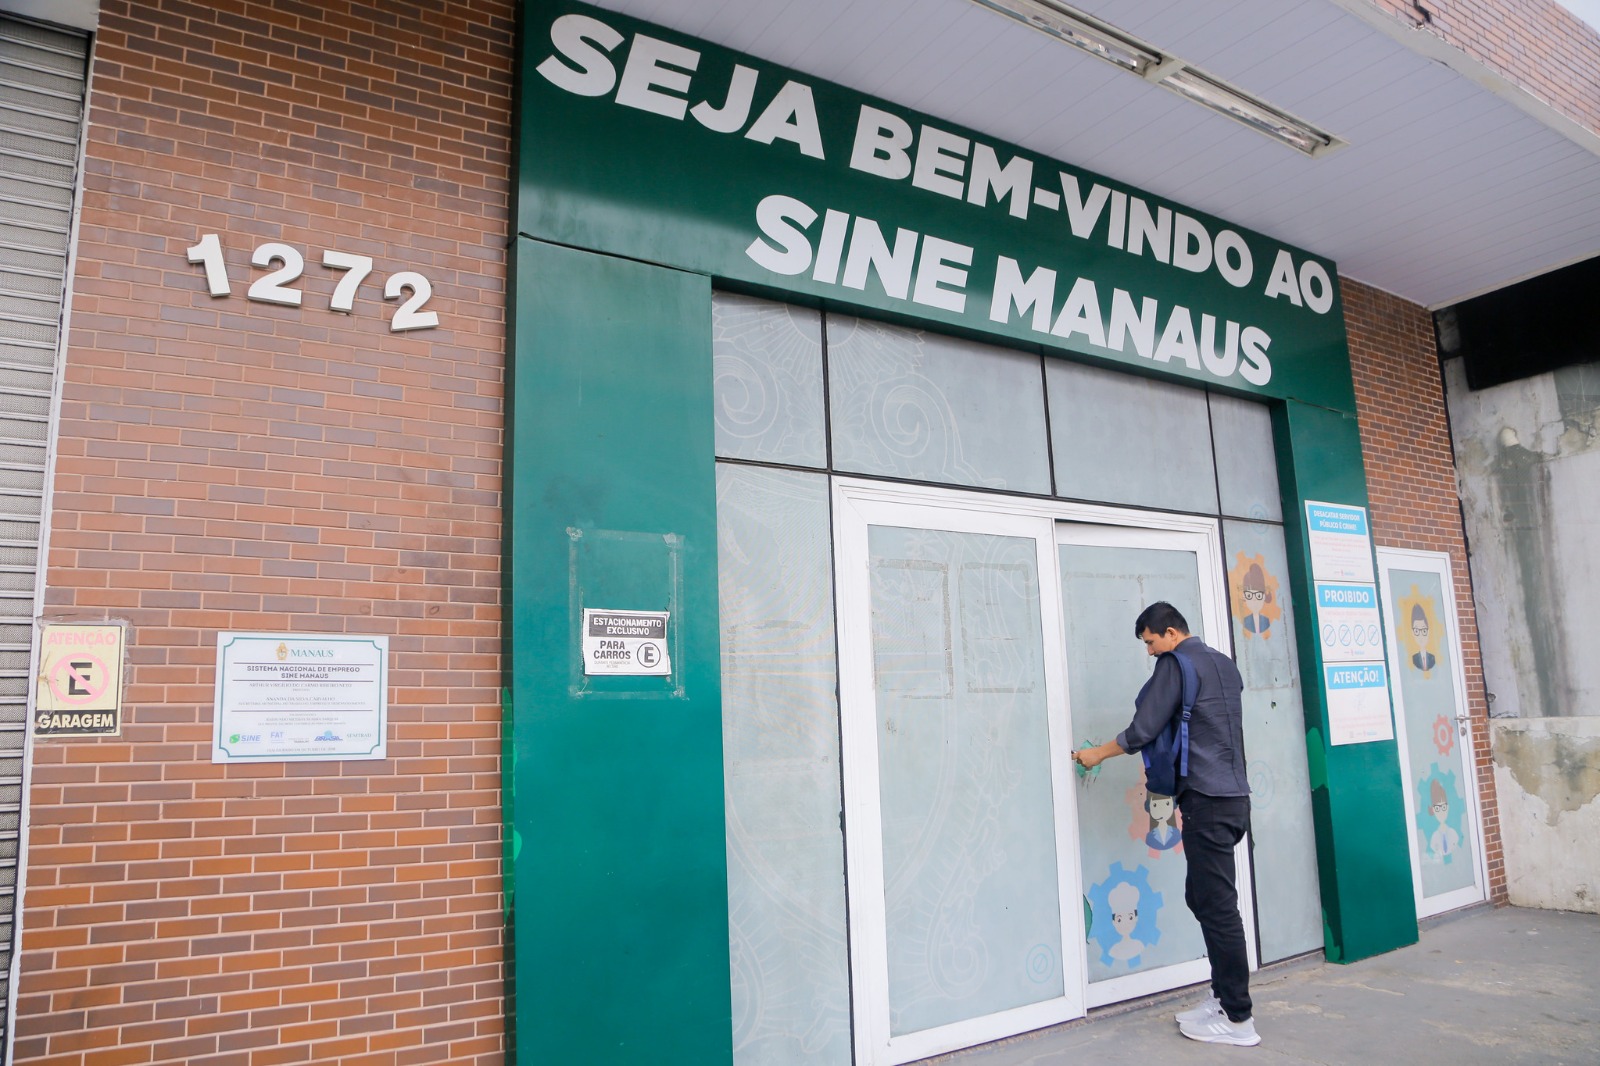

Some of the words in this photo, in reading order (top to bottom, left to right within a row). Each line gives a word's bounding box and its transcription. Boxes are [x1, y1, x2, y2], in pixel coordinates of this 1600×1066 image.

[535, 13, 826, 161] SEJA
[849, 104, 1254, 289] BEM-VINDO
[1264, 249, 1334, 315] AO
[187, 233, 439, 332] 1272
[745, 194, 974, 313] SINE
[989, 254, 1273, 386] MANAUS
[1324, 590, 1369, 603] PROIBIDO
[593, 617, 662, 628] ESTACIONAMENTO
[606, 627, 650, 636] EXCLUSIVO
[47, 629, 117, 649] ATENÇÃO
[600, 640, 625, 650] PARA
[290, 649, 334, 658] MANAUS
[593, 650, 631, 660] CARROS
[644, 647, 655, 663] E
[1333, 667, 1379, 687] ATENÇÃO!
[37, 713, 114, 729] GARAGEM
[240, 734, 261, 742] SINE
[270, 731, 284, 739] FAT
